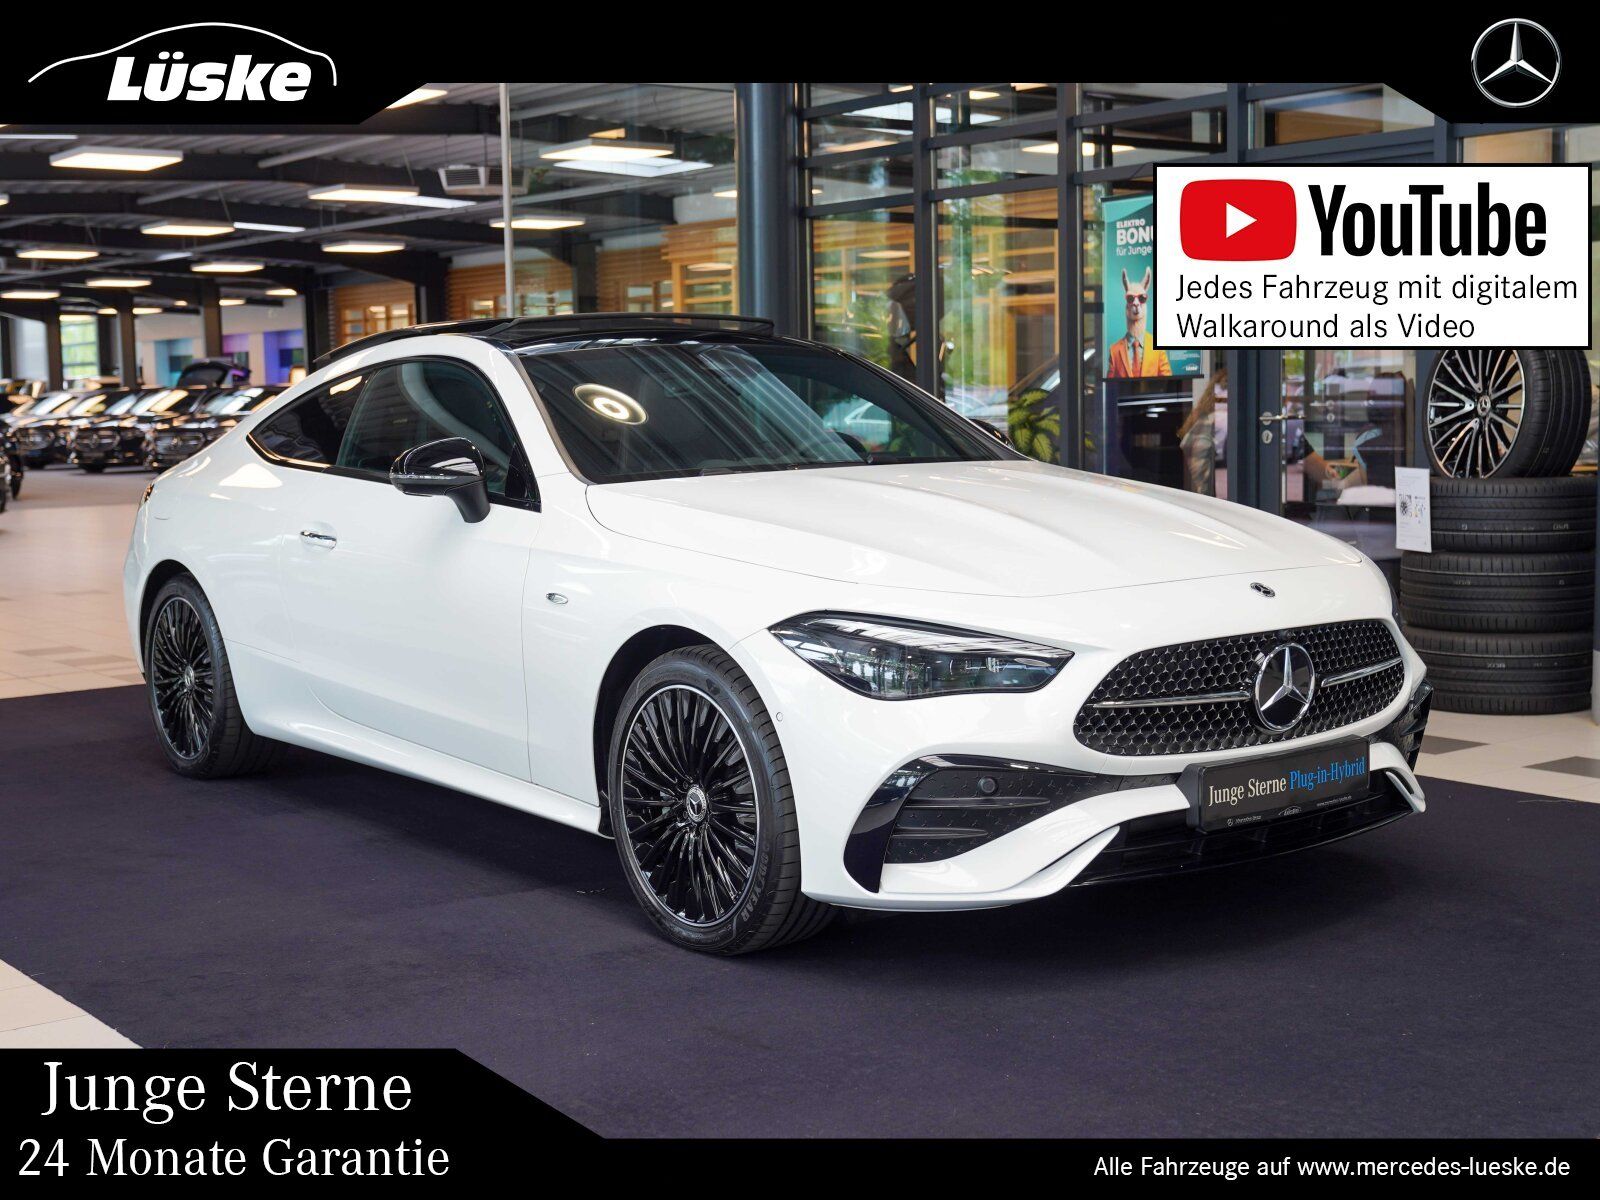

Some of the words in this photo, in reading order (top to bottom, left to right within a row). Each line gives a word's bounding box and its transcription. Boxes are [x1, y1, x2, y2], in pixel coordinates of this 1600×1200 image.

[1116, 219, 1146, 228] ELEKTRO
[1128, 246, 1152, 255] Junge
[1208, 785, 1245, 806] Junge
[1247, 777, 1287, 798] Sterne
[1289, 756, 1365, 792] Plug-in-Hybrid
